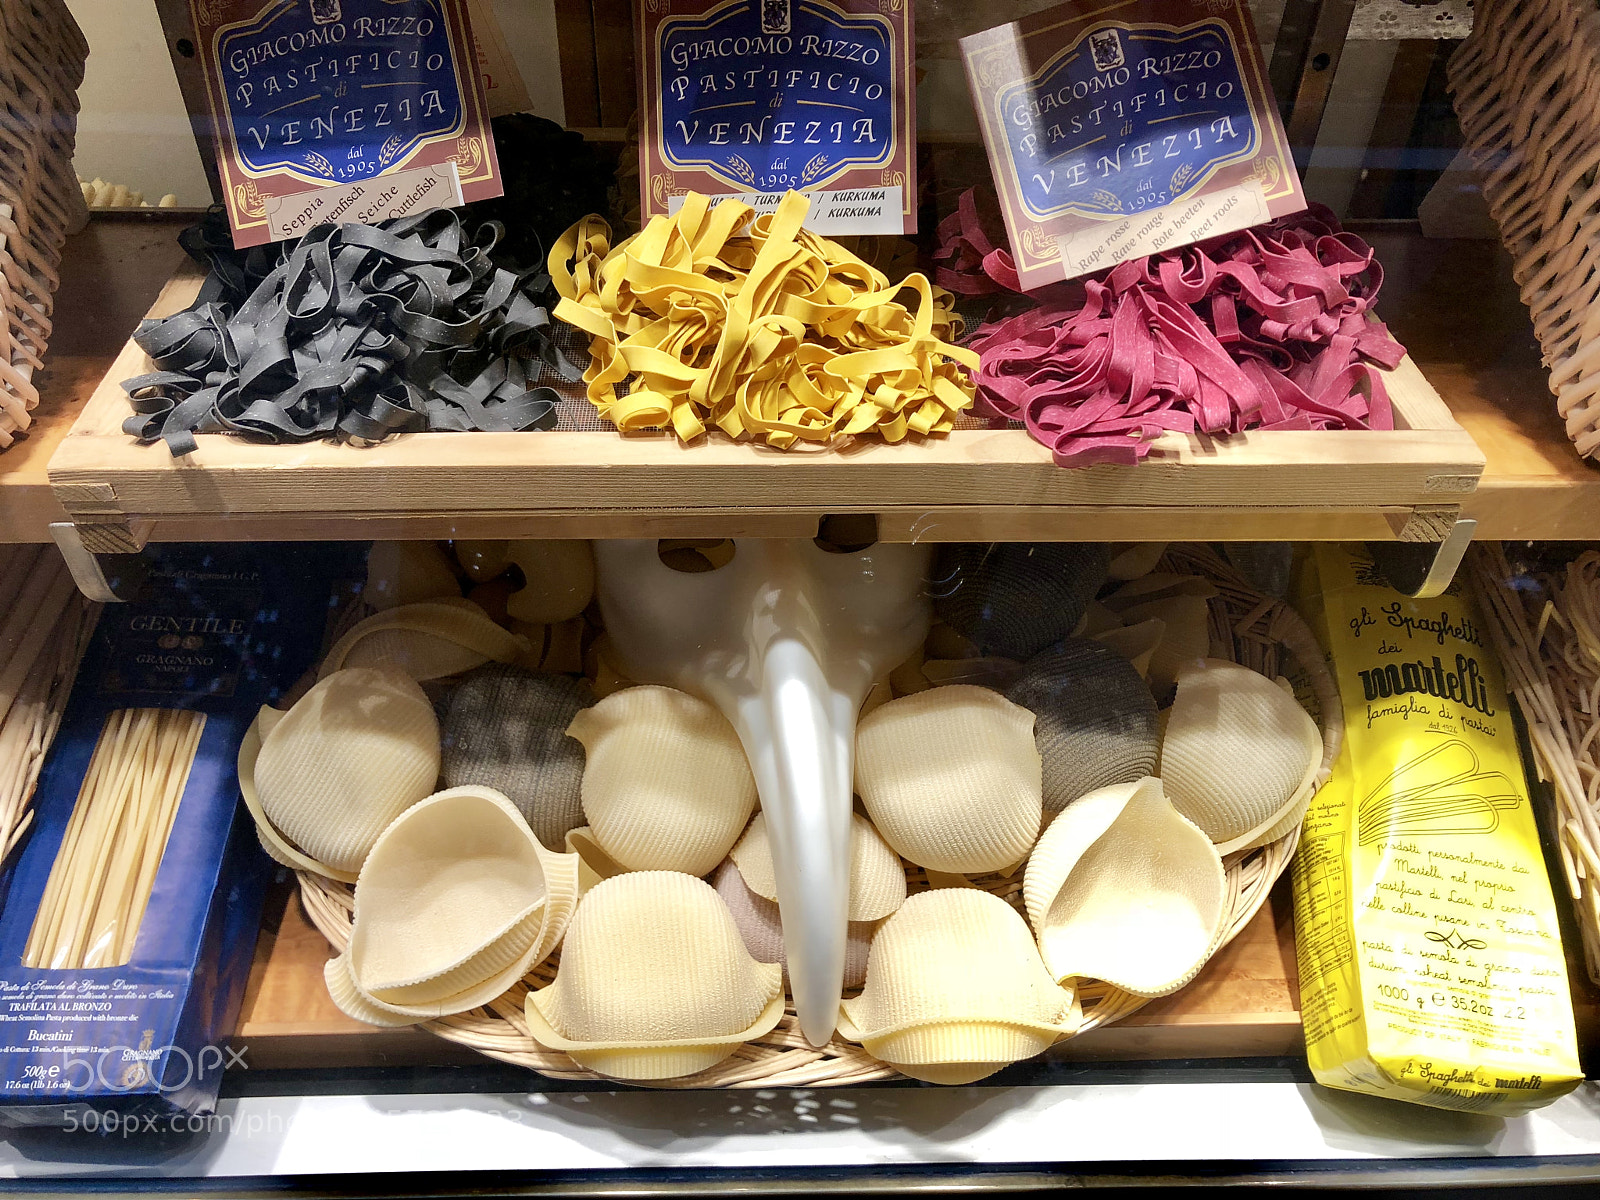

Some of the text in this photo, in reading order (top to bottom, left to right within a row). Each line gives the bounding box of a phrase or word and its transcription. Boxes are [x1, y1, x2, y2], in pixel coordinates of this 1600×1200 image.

[230, 16, 434, 79] GIACOMO RIZZO
[670, 35, 880, 72] GIACOMO RIZZO
[236, 50, 443, 108] PASTIFICIO
[334, 81, 348, 98] di
[670, 65, 884, 101] PASTIFICIO
[1012, 50, 1222, 130] GIACOMO RIZZO
[769, 92, 783, 108] di
[248, 89, 446, 151] VENEZIA
[675, 115, 877, 145] VENEZIA
[1020, 81, 1234, 158] PASTIFICIO
[1120, 120, 1134, 138] di
[347, 144, 364, 160] dal
[771, 157, 788, 170] dal
[1032, 115, 1239, 195] VENEZIA
[338, 160, 376, 179] 1905
[759, 174, 798, 188] 1905
[388, 176, 437, 219] Cuttlefish
[832, 190, 886, 202] KURKUMA
[1136, 177, 1153, 193] dal
[358, 185, 399, 224] Seiche
[828, 206, 882, 218] KURKUMA
[1128, 191, 1166, 211] 1905
[282, 197, 324, 236] Seppia
[1152, 198, 1206, 250] Rote beeten
[1190, 195, 1239, 243] Beet roots
[1078, 219, 1131, 271] Rape rosse
[1111, 211, 1165, 262] Rave rouge
[130, 615, 246, 635] GENTILE
[1350, 602, 1483, 648] gli Spaghetti
[136, 654, 214, 667] GRAGNANO
[1378, 640, 1402, 654] dei
[1358, 653, 1495, 717] martelli
[1367, 696, 1430, 729] famiglia
[1439, 703, 1453, 720] di
[1427, 850, 1506, 871] personalmente
[1511, 859, 1531, 875] dai
[1375, 880, 1423, 899] pastificio
[1430, 888, 1441, 900] di
[1482, 897, 1495, 910] al
[1451, 871, 1468, 884] nel
[1474, 878, 1516, 896] proprio
[1391, 902, 1428, 919] colline
[1434, 913, 1471, 931] pisane
[1362, 940, 1394, 954] pasta
[1419, 949, 1460, 965] semola
[1414, 964, 1451, 982] wheat
[9, 1002, 112, 1012] TRAFILATA AL BRONZO
[1377, 984, 1409, 1001] 1000
[1451, 995, 1494, 1018] 35.2oz
[62, 1014, 92, 1023] produced
[27, 1029, 74, 1042] Bucatini
[5, 1080, 21, 1089] 17.6
[1400, 1062, 1415, 1078] gli
[1420, 1063, 1476, 1087] Spaghetti
[1495, 1076, 1542, 1090] martelli
